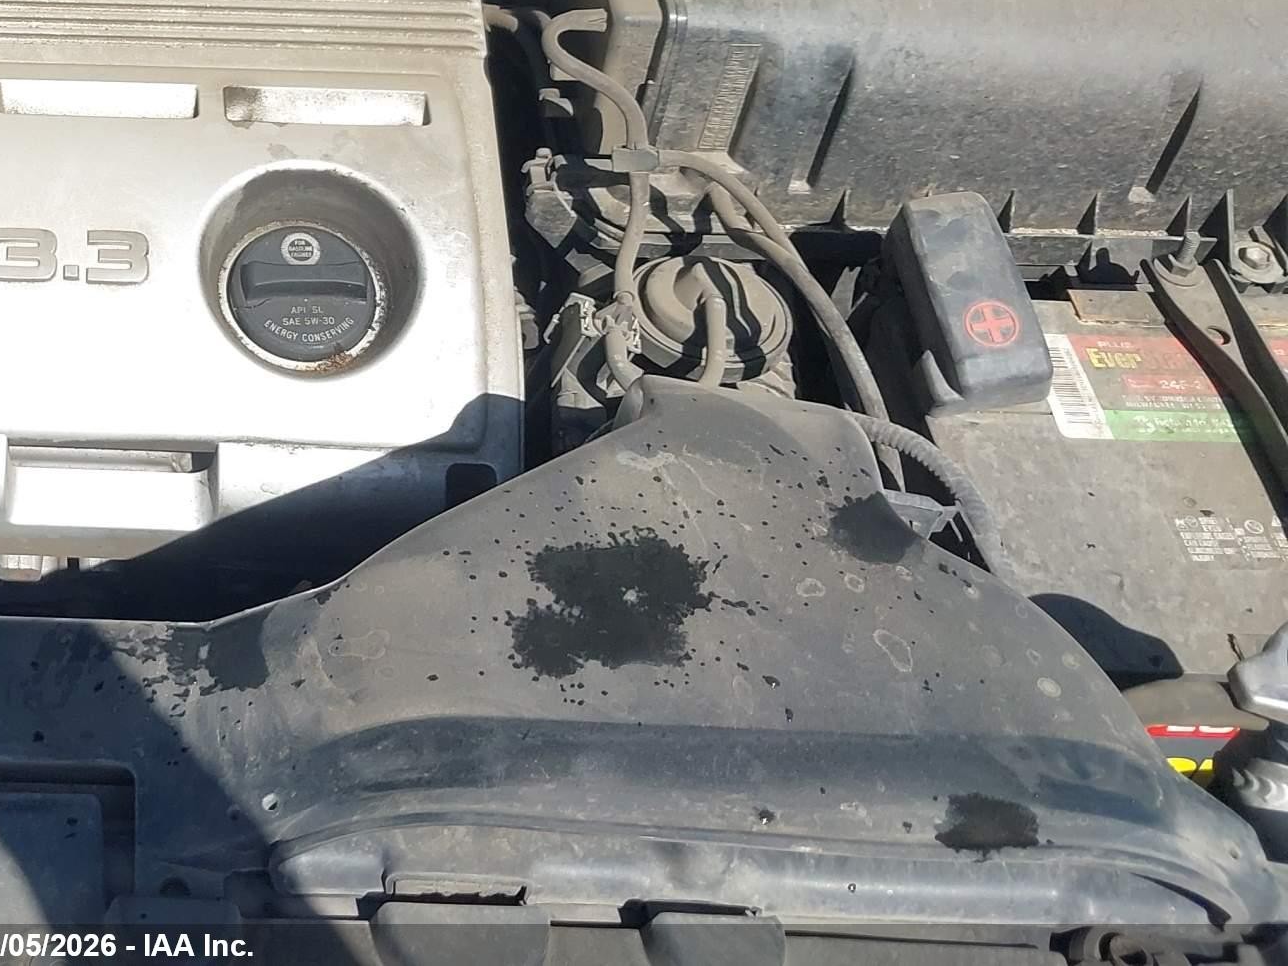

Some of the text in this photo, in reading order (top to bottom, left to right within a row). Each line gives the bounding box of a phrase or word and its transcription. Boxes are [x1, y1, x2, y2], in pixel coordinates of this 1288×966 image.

[291, 306, 324, 314] API SL
[282, 317, 335, 326] SAE 5W-30
[263, 316, 355, 342] ENERGY CONSERVING
